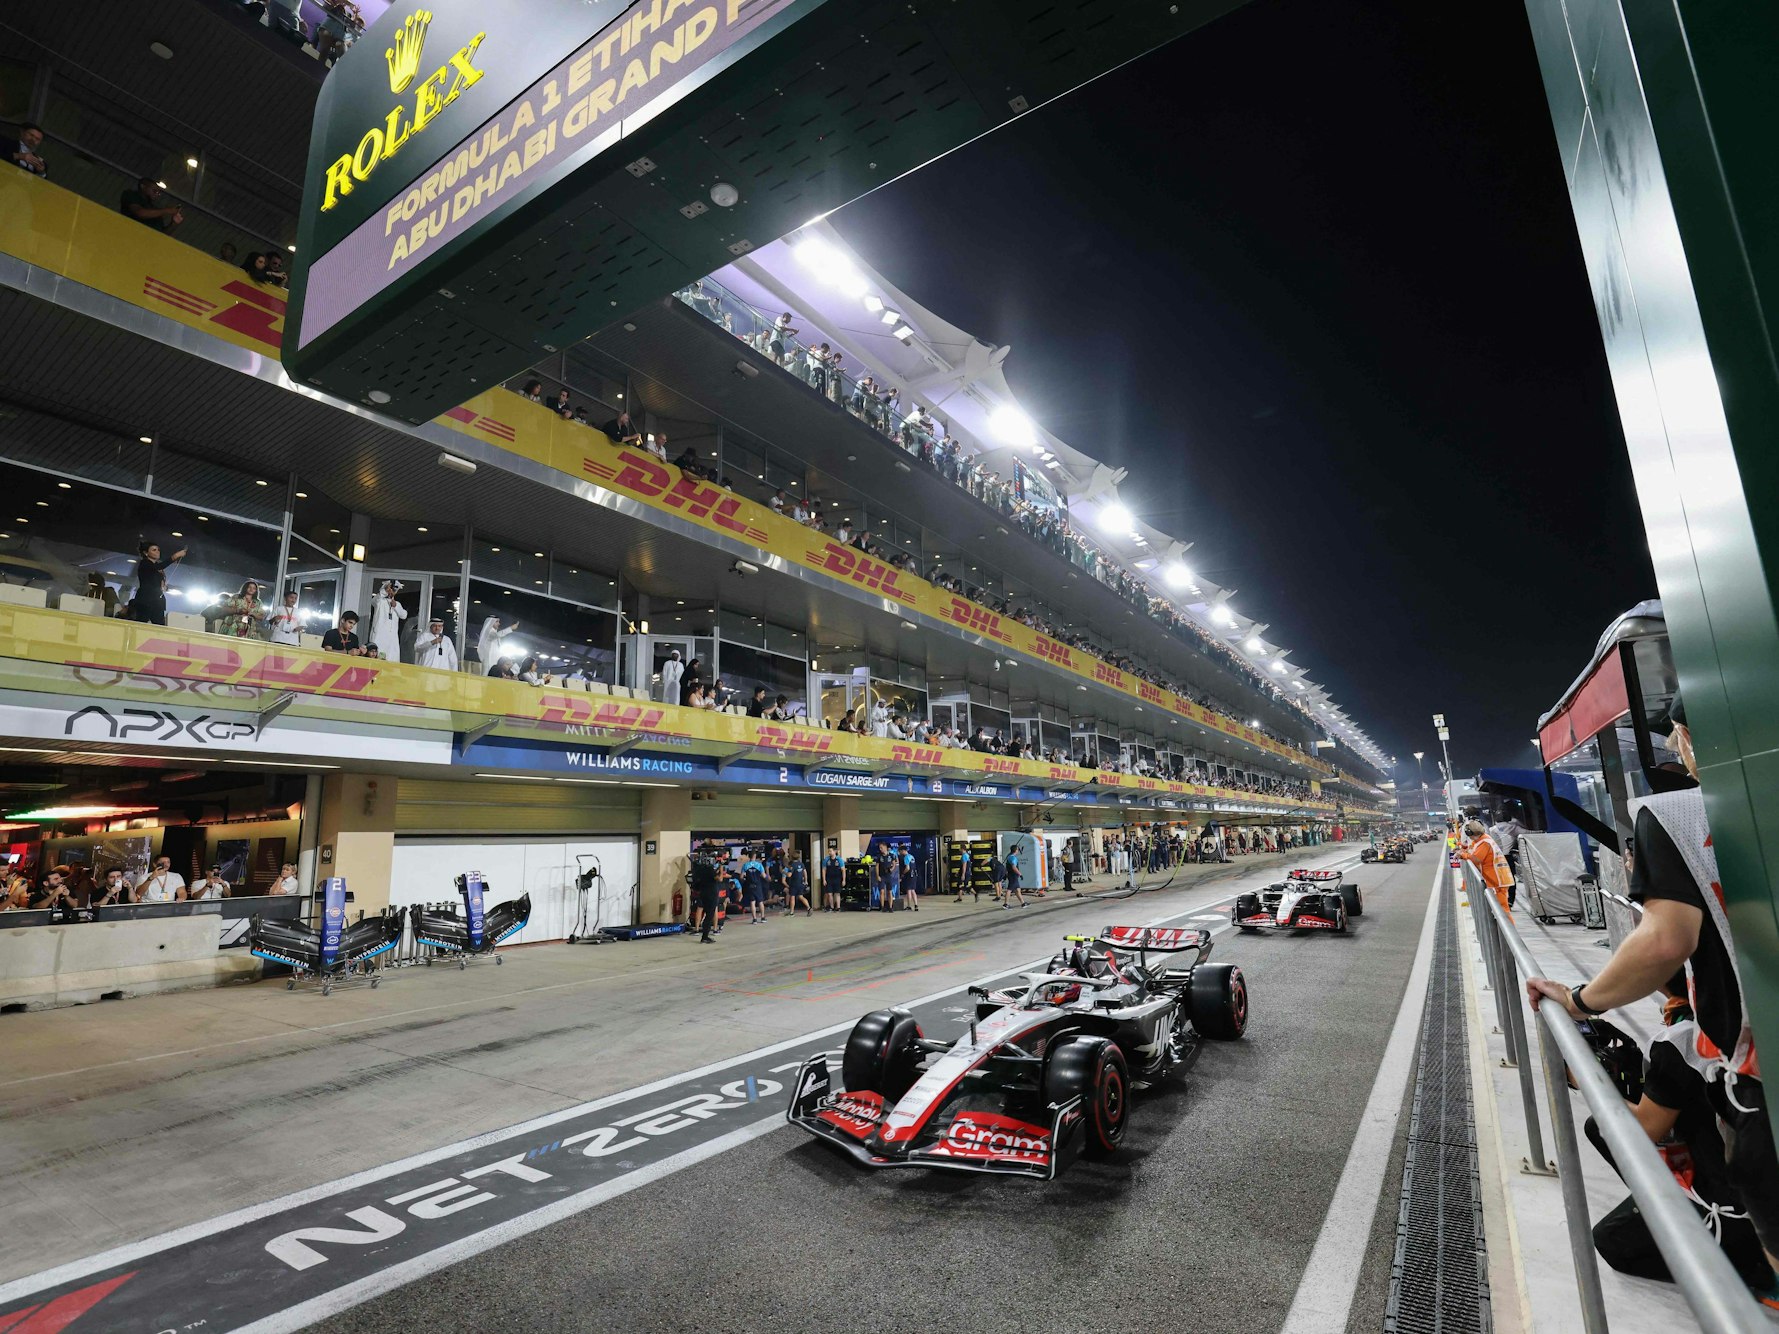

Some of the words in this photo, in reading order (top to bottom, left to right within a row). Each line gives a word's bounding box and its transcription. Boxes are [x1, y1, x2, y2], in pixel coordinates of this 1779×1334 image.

[320, 31, 486, 213] ROLEX
[387, 199, 450, 271] ABU
[452, 121, 558, 223] DHABI
[562, 6, 718, 138] GRAND
[385, 99, 536, 237] FORMULA
[542, 80, 562, 116] 1
[613, 450, 748, 534] DHL
[823, 542, 904, 599] DHL
[950, 597, 1004, 639] DHL
[1035, 634, 1073, 668] DHL
[1096, 662, 1124, 689] DHL
[566, 751, 641, 770] WILLIAMS
[642, 759, 693, 774] RACING
[779, 766, 788, 783] 2
[815, 772, 847, 785] LOGAN
[932, 780, 942, 793] 23
[322, 849, 332, 859] 40
[332, 877, 342, 891] 2
[466, 871, 480, 883] 23
[424, 936, 462, 950] MYPROTEIN
[635, 927, 661, 937] WILLIAMS
[262, 948, 310, 968] MYPROTEIN
[352, 939, 391, 961] MYPROTEIN
[947, 1117, 1048, 1158] Gram
[265, 1152, 553, 1271] NET
[562, 1075, 784, 1158] ZERO
